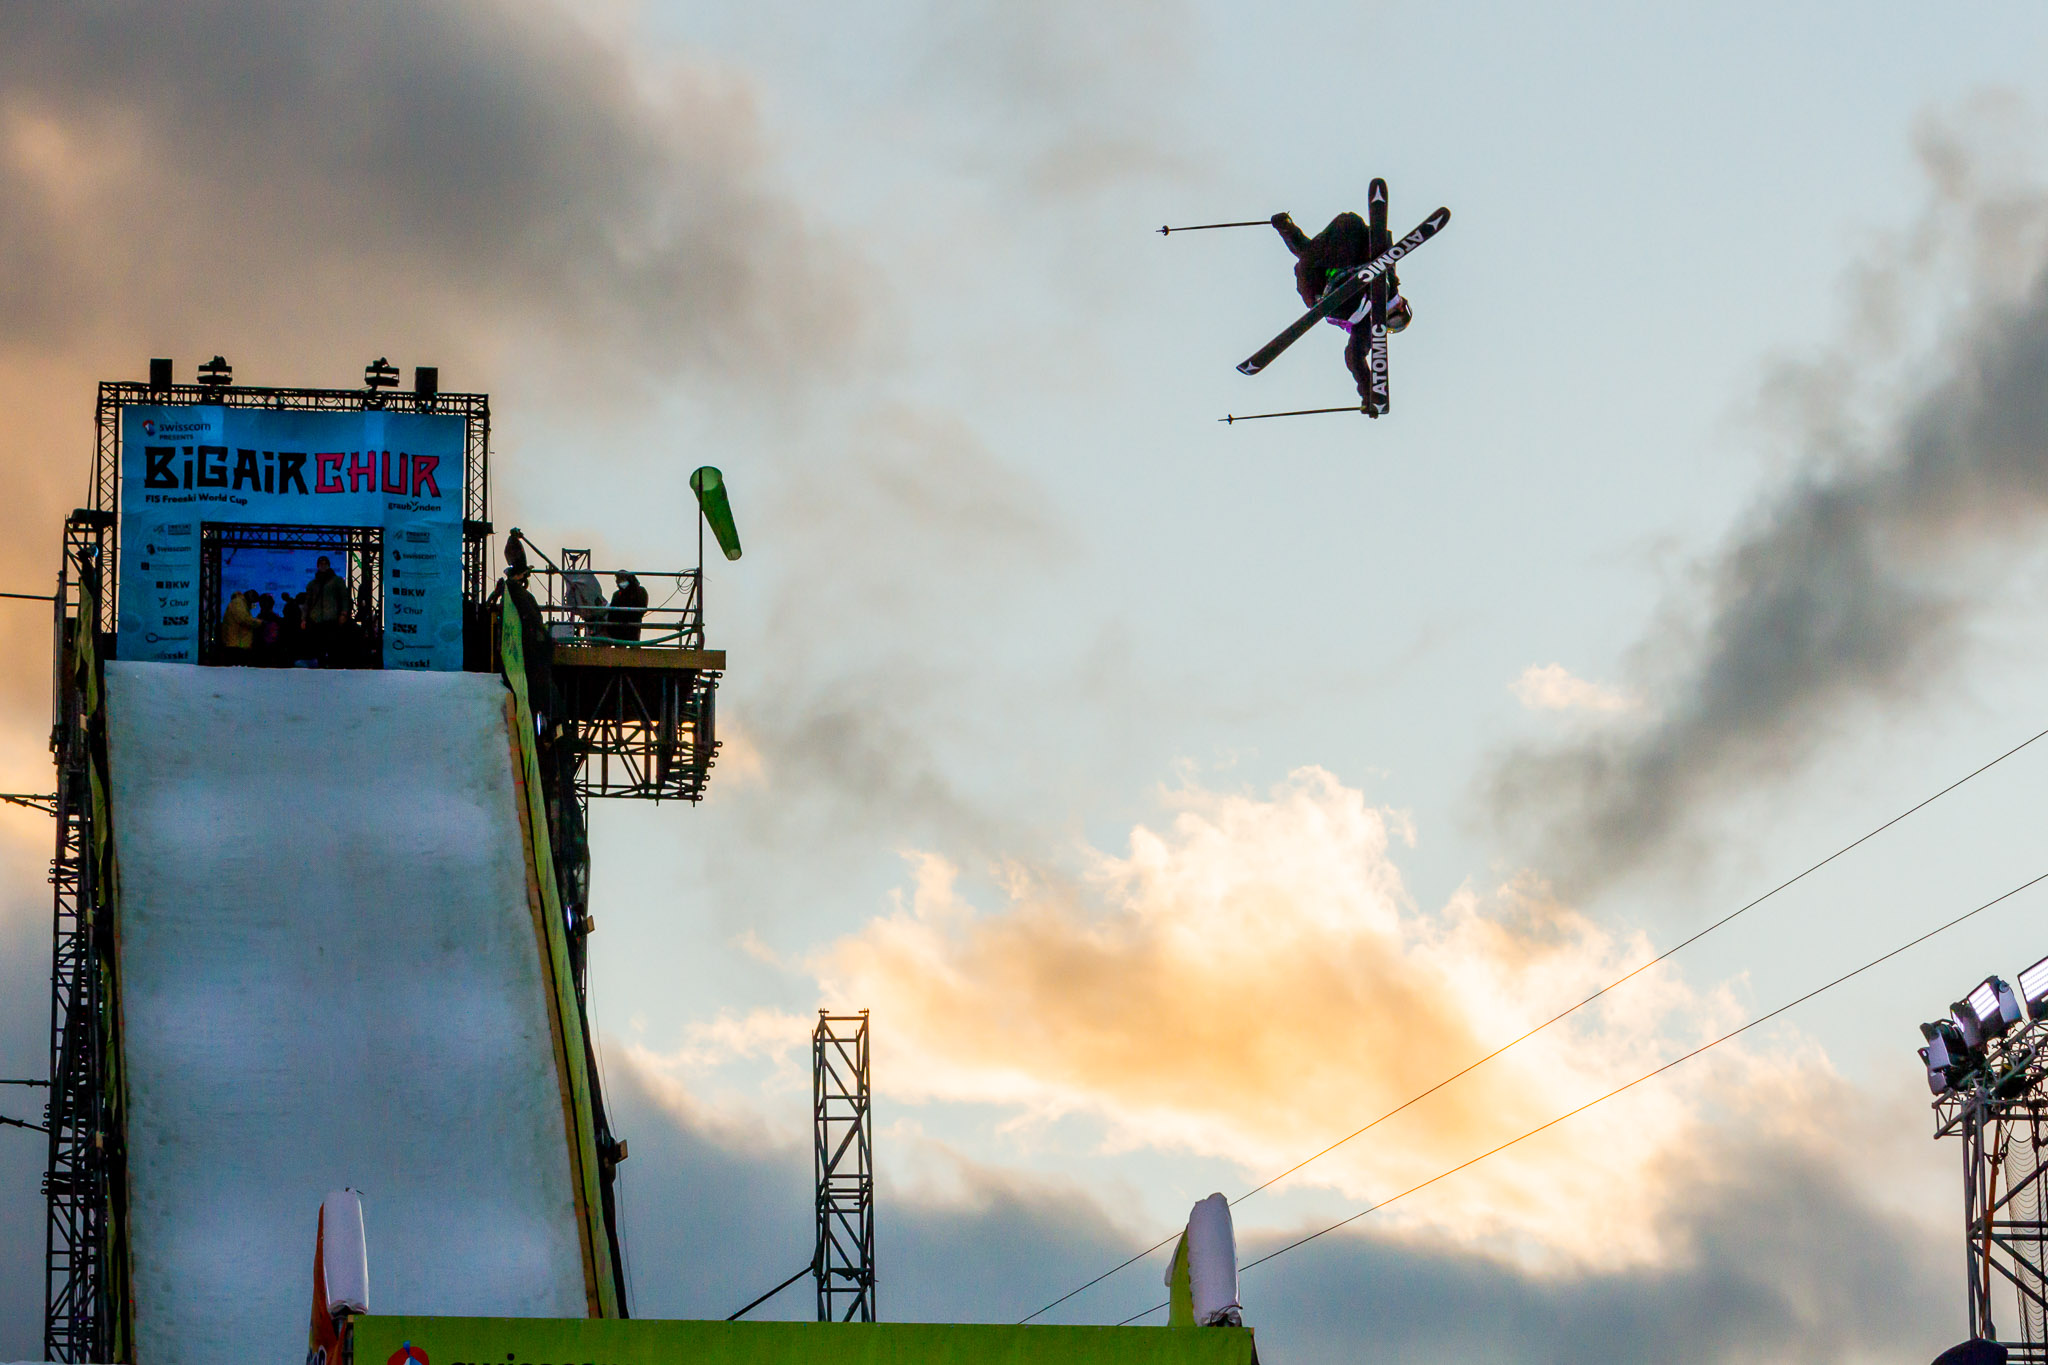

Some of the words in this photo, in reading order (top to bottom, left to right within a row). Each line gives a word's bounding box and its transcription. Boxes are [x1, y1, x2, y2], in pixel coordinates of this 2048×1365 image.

[1357, 229, 1425, 283] ATOMIC
[1371, 324, 1388, 397] ATOMIC
[159, 421, 211, 432] swisscom
[145, 494, 161, 503] FIS
[162, 494, 197, 503] Freeski
[198, 493, 228, 503] World
[229, 495, 248, 506] Cup
[165, 581, 190, 589] BKW
[401, 588, 425, 597] BKW
[169, 599, 190, 607] Chur
[403, 606, 423, 615] Chur
